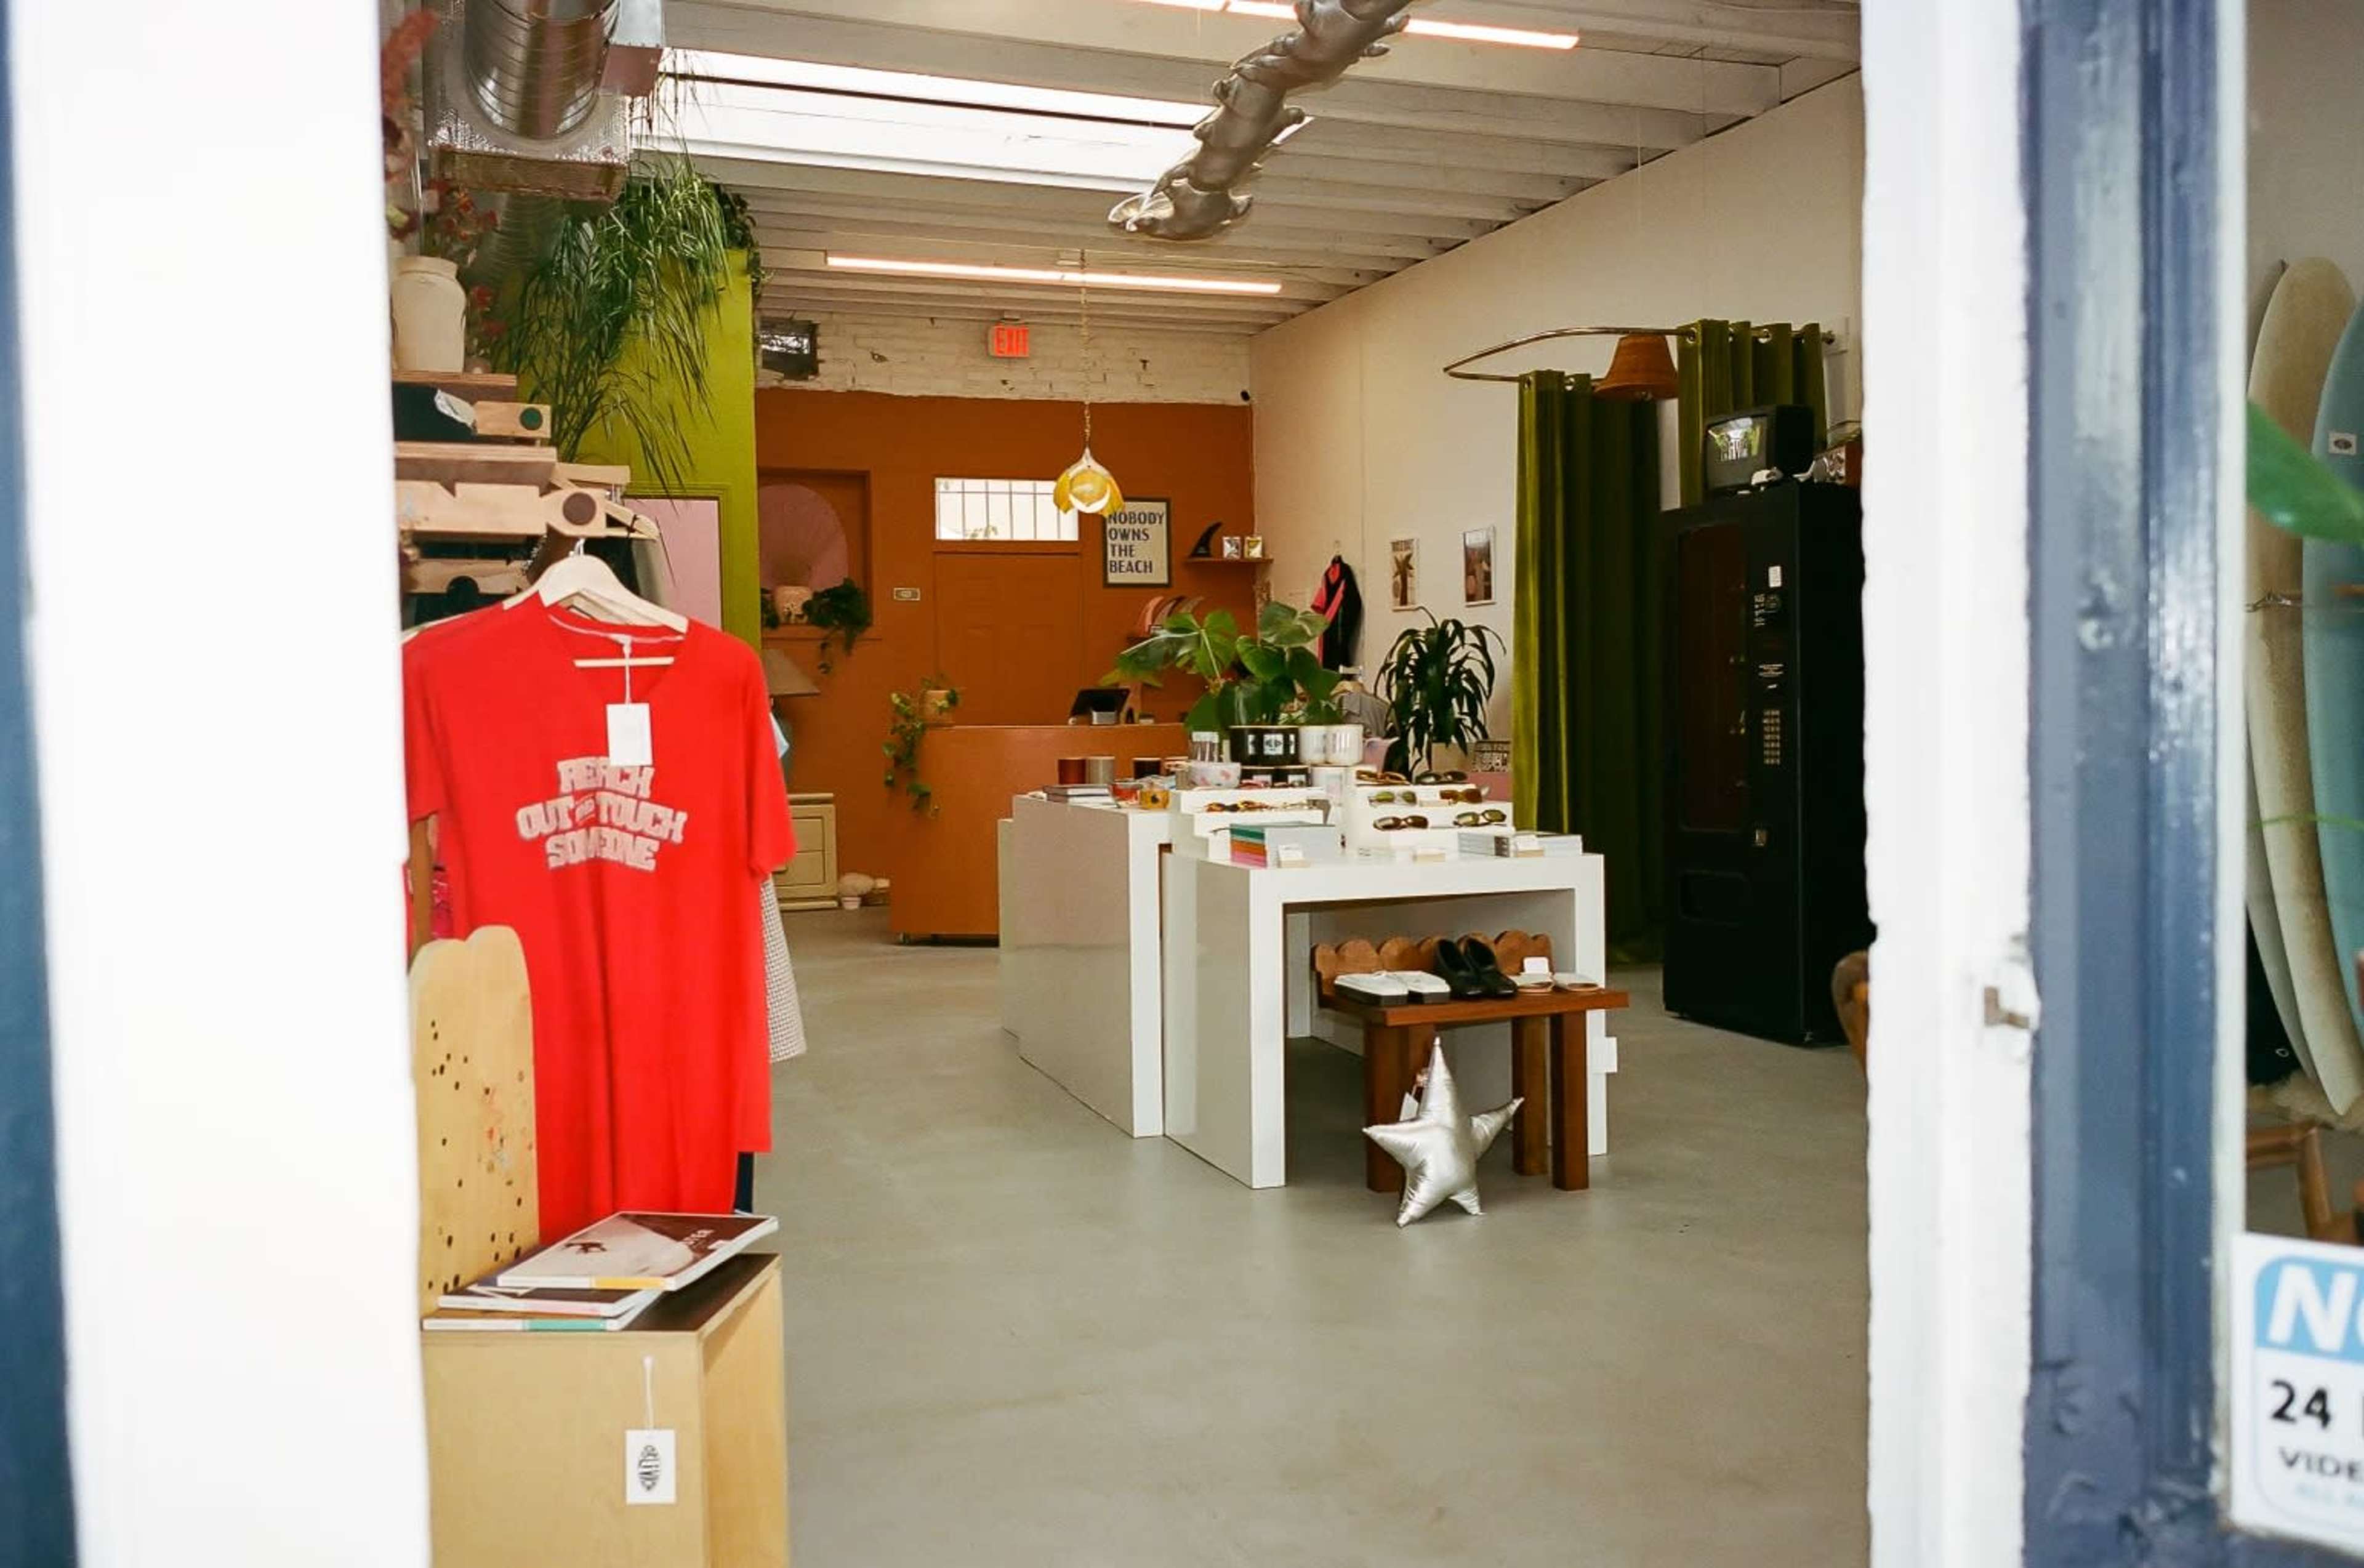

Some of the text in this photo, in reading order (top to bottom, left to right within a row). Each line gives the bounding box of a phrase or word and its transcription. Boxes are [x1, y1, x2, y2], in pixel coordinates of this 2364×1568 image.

[994, 326, 1029, 356] EXIT
[1108, 511, 1165, 525] NOBODY
[1109, 528, 1150, 541] OWNS
[1110, 544, 1135, 558] THE
[1109, 560, 1153, 573] BEACH
[557, 756, 654, 798] REACH
[516, 795, 575, 840] OUT
[595, 790, 688, 844] TOUCH
[2268, 1263, 2364, 1353] N
[2271, 1379, 2331, 1429] 24
